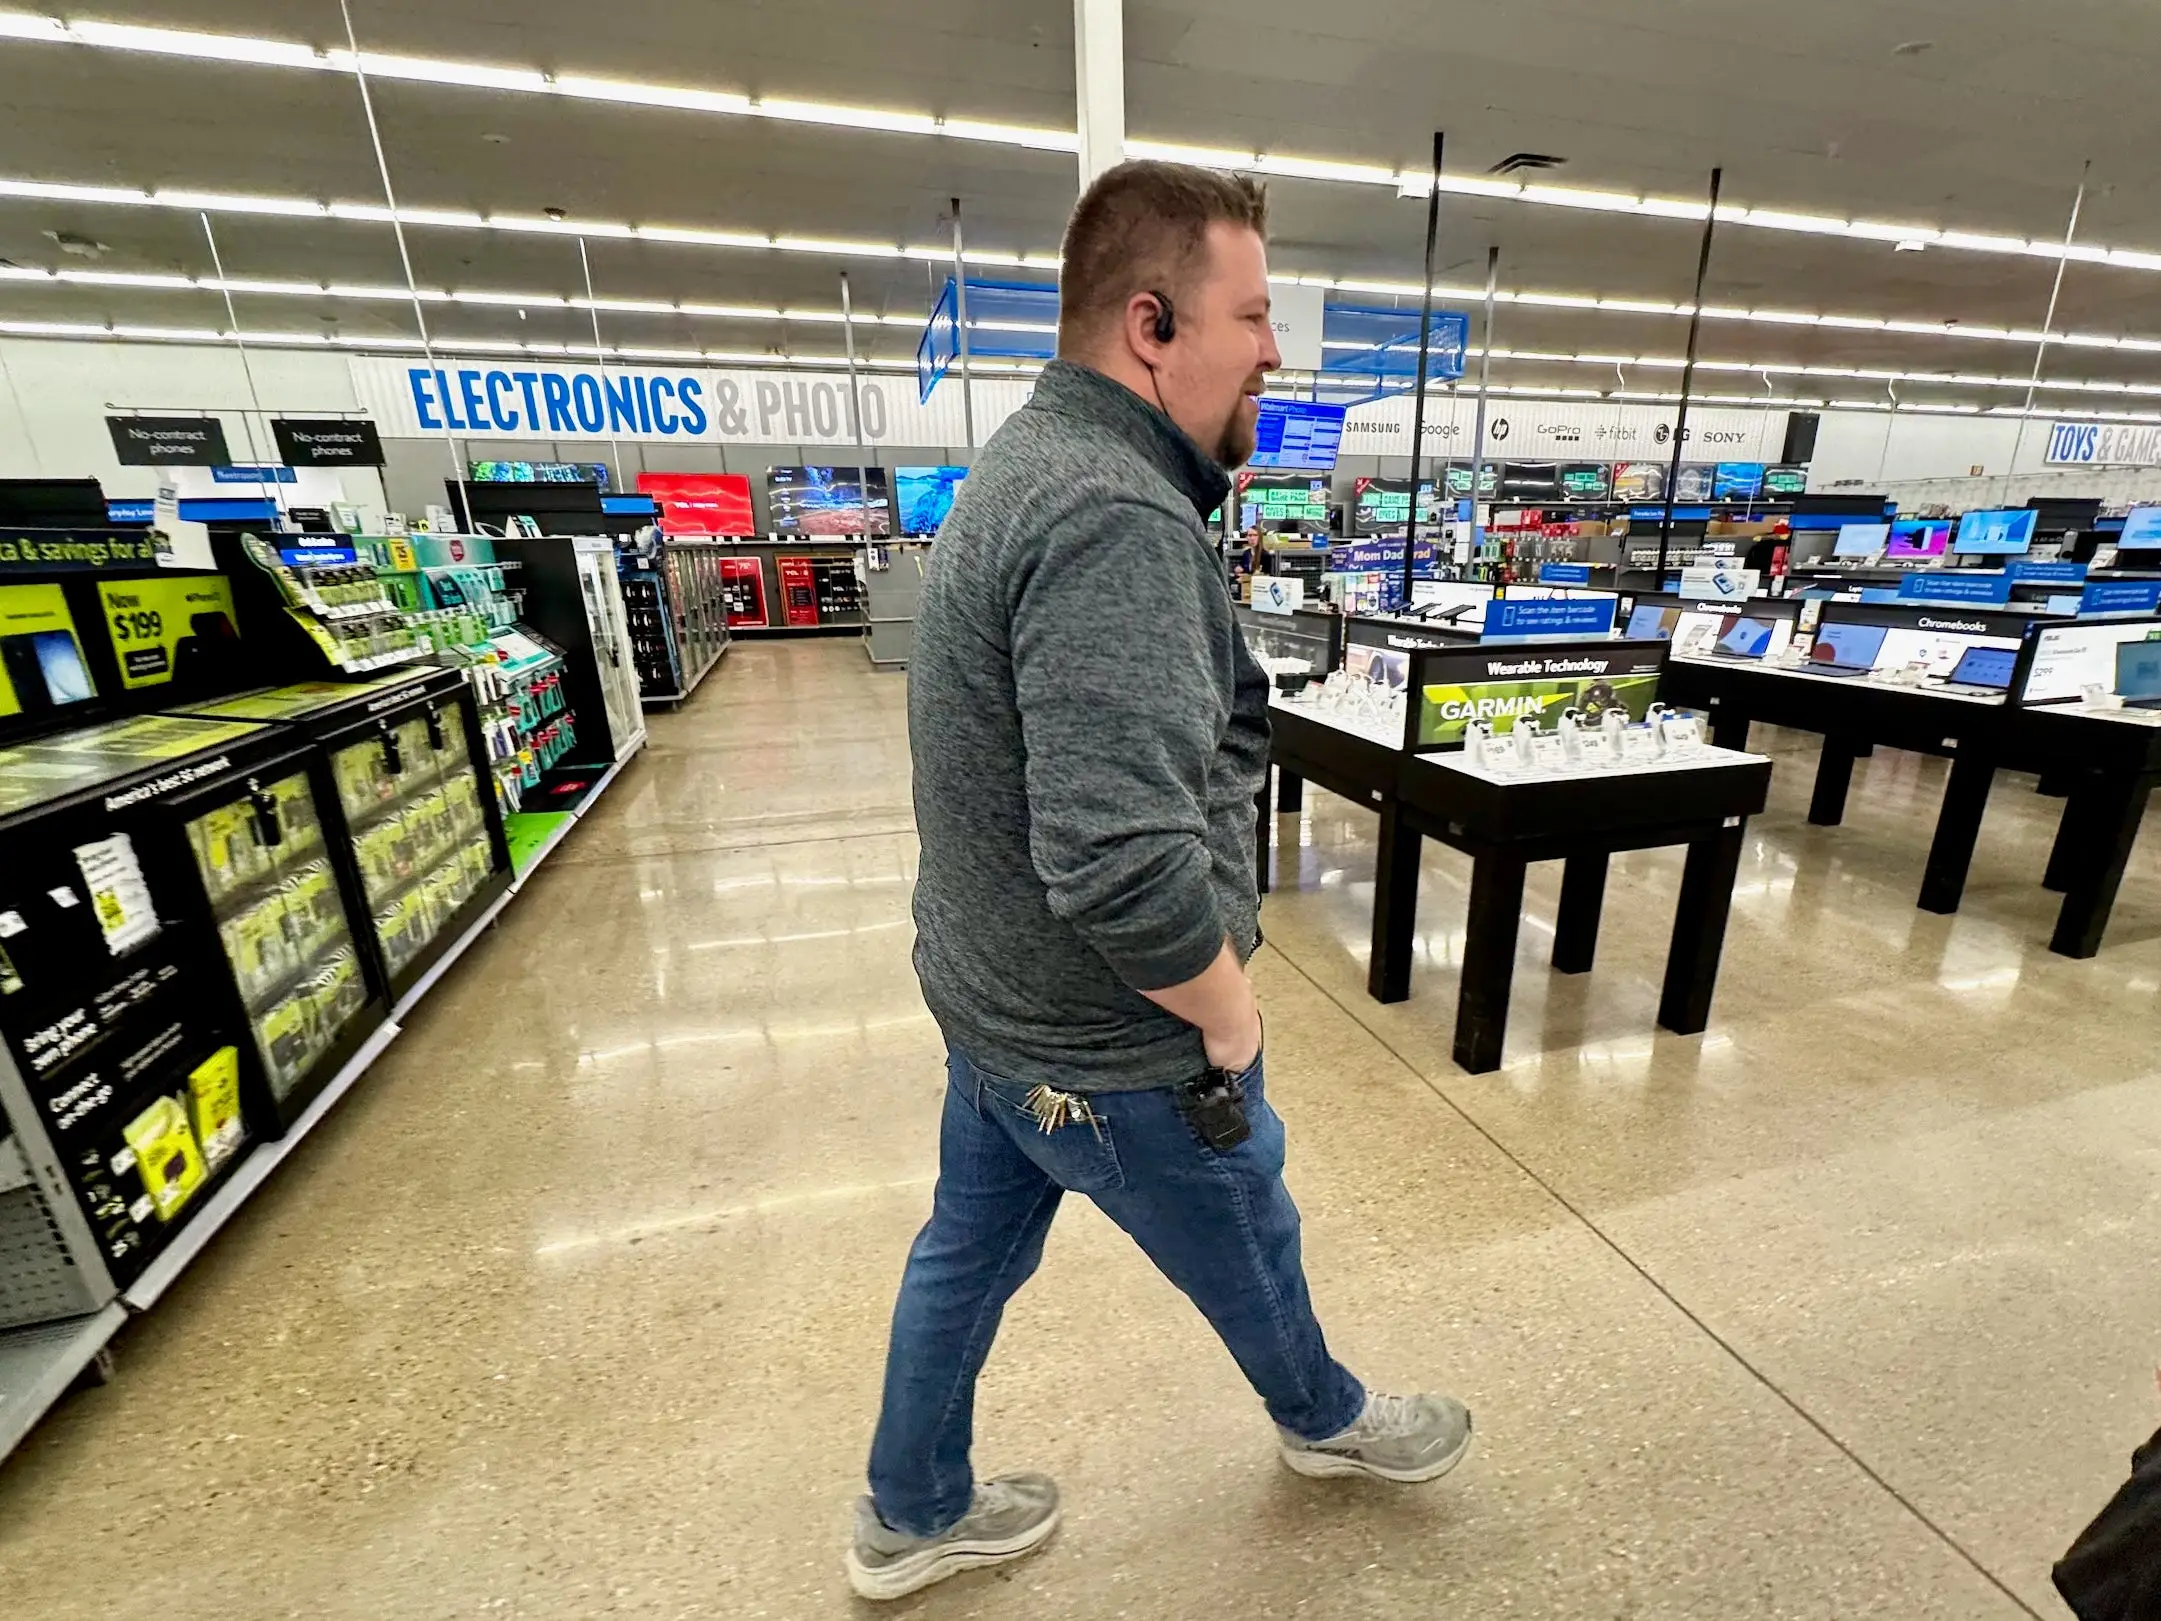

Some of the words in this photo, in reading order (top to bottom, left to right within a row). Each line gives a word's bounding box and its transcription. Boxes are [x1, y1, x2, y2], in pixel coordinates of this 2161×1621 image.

[408, 368, 707, 436] ELECTRONICS
[717, 377, 748, 436] &
[758, 380, 888, 440] PHOTO
[128, 428, 207, 442] No-contract
[1345, 421, 1400, 434] SAMSUNG
[1537, 424, 1581, 434] GoPro
[1609, 424, 1637, 440] fitbit
[292, 431, 365, 444] No-contract
[1703, 431, 1746, 443] SONY
[2051, 425, 2098, 461] TOYS
[2097, 427, 2113, 461] &
[150, 442, 196, 456] phones
[311, 445, 354, 459] phones
[39, 537, 109, 566] savings
[1353, 550, 1380, 562] Mom
[1382, 549, 1405, 561] Dad
[1412, 547, 1431, 559] rad
[1518, 605, 1537, 615] Scan
[1537, 606, 1549, 614] the
[114, 610, 163, 641] $199
[1917, 617, 1987, 633] Chromebooks
[1487, 660, 1542, 675] Wearable
[1543, 658, 1609, 674] Technology
[1441, 696, 1544, 720] GARMIN
